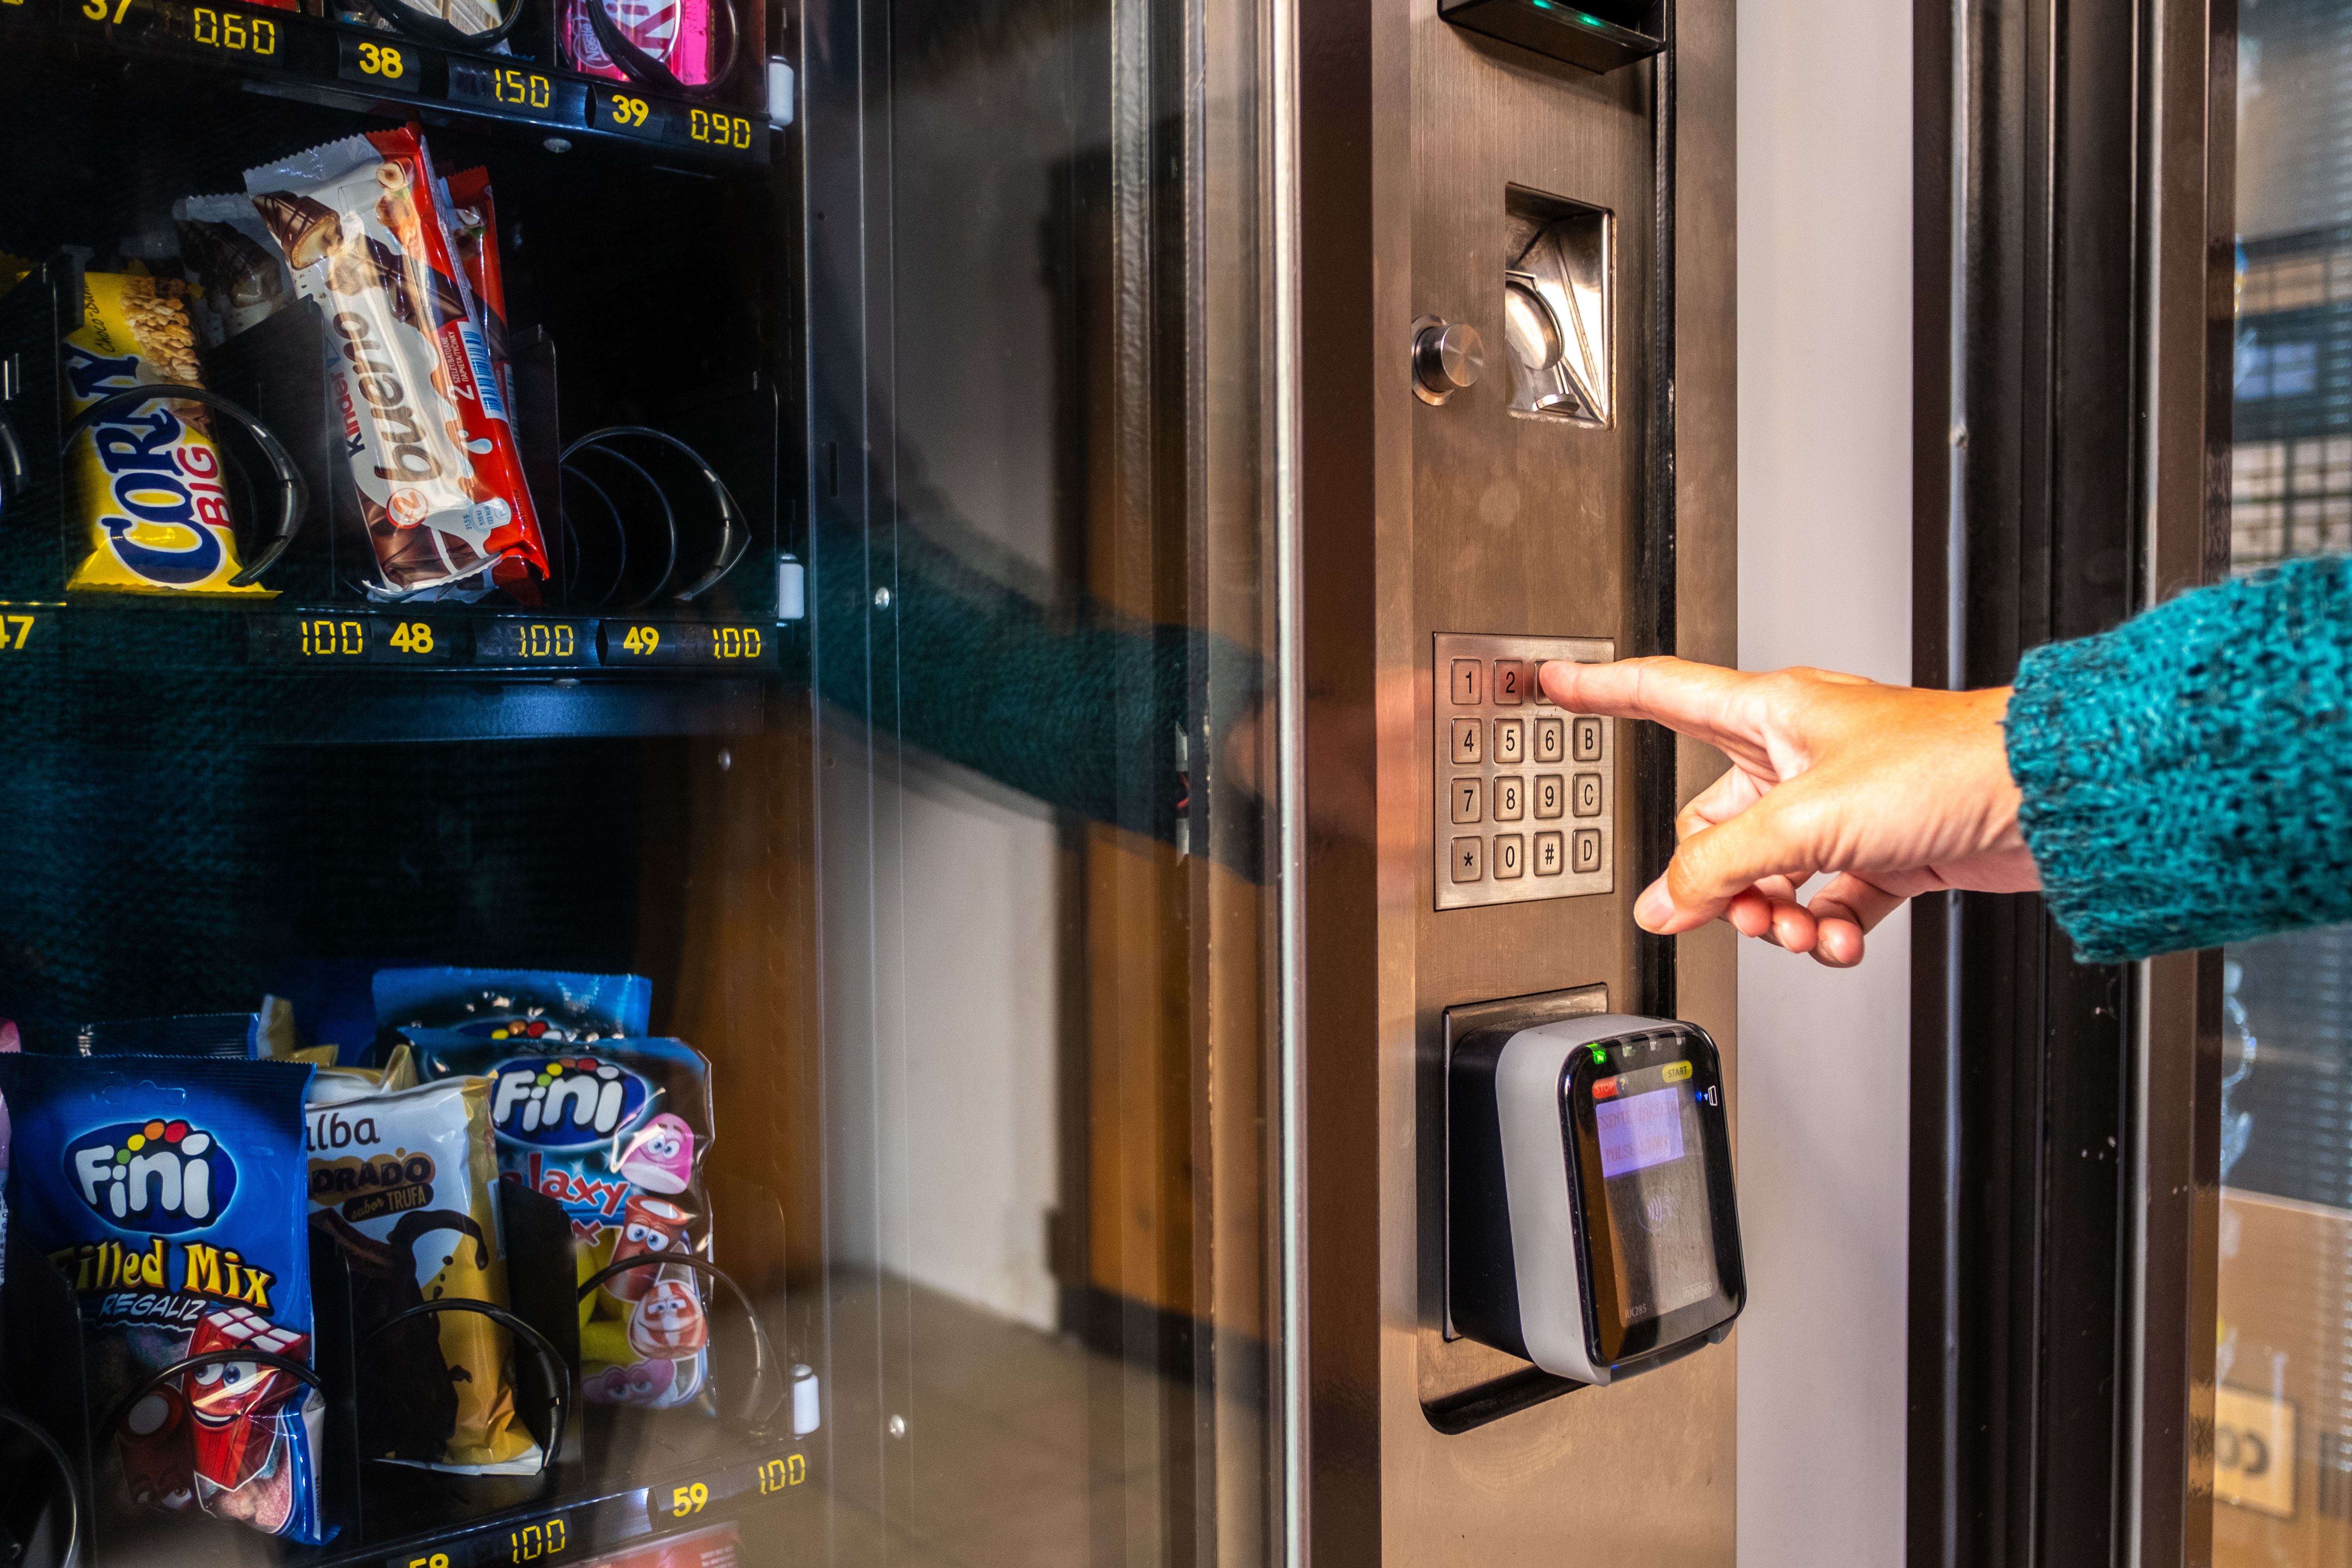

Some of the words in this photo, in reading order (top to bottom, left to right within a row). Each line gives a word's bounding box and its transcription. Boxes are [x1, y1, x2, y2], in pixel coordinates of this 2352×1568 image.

[358, 43, 403, 78] 38
[612, 95, 649, 127] 39
[333, 311, 442, 482] bueno
[447, 385, 475, 400] 2
[63, 341, 221, 584] CORNY
[177, 446, 232, 528] BIG
[390, 622, 434, 653] 48
[623, 627, 659, 655] 49
[1466, 671, 1472, 694] 1
[1506, 671, 1515, 694] 2
[1464, 729, 1474, 753] 4
[1506, 730, 1515, 752] 5
[1545, 730, 1554, 751] 6
[1585, 728, 1593, 750] B
[1464, 789, 1474, 812] 7
[1506, 788, 1515, 810] 8
[1545, 786, 1554, 807] 9
[1584, 784, 1593, 806] C
[1506, 846, 1515, 868] 0
[1545, 844, 1554, 865] #
[1584, 840, 1592, 861] D
[1595, 1082, 1614, 1094] STOP
[1668, 1065, 1687, 1078] START
[493, 1066, 623, 1133] Fini
[75, 1134, 210, 1219] Fini
[499, 1151, 631, 1217] laxy
[351, 1197, 385, 1220] sabor
[387, 1186, 427, 1211] TRUFA
[184, 1243, 273, 1308] Mix
[1683, 1282, 1713, 1299] ingenico
[100, 1293, 206, 1321] REGALIZ
[673, 1482, 709, 1518] 59
